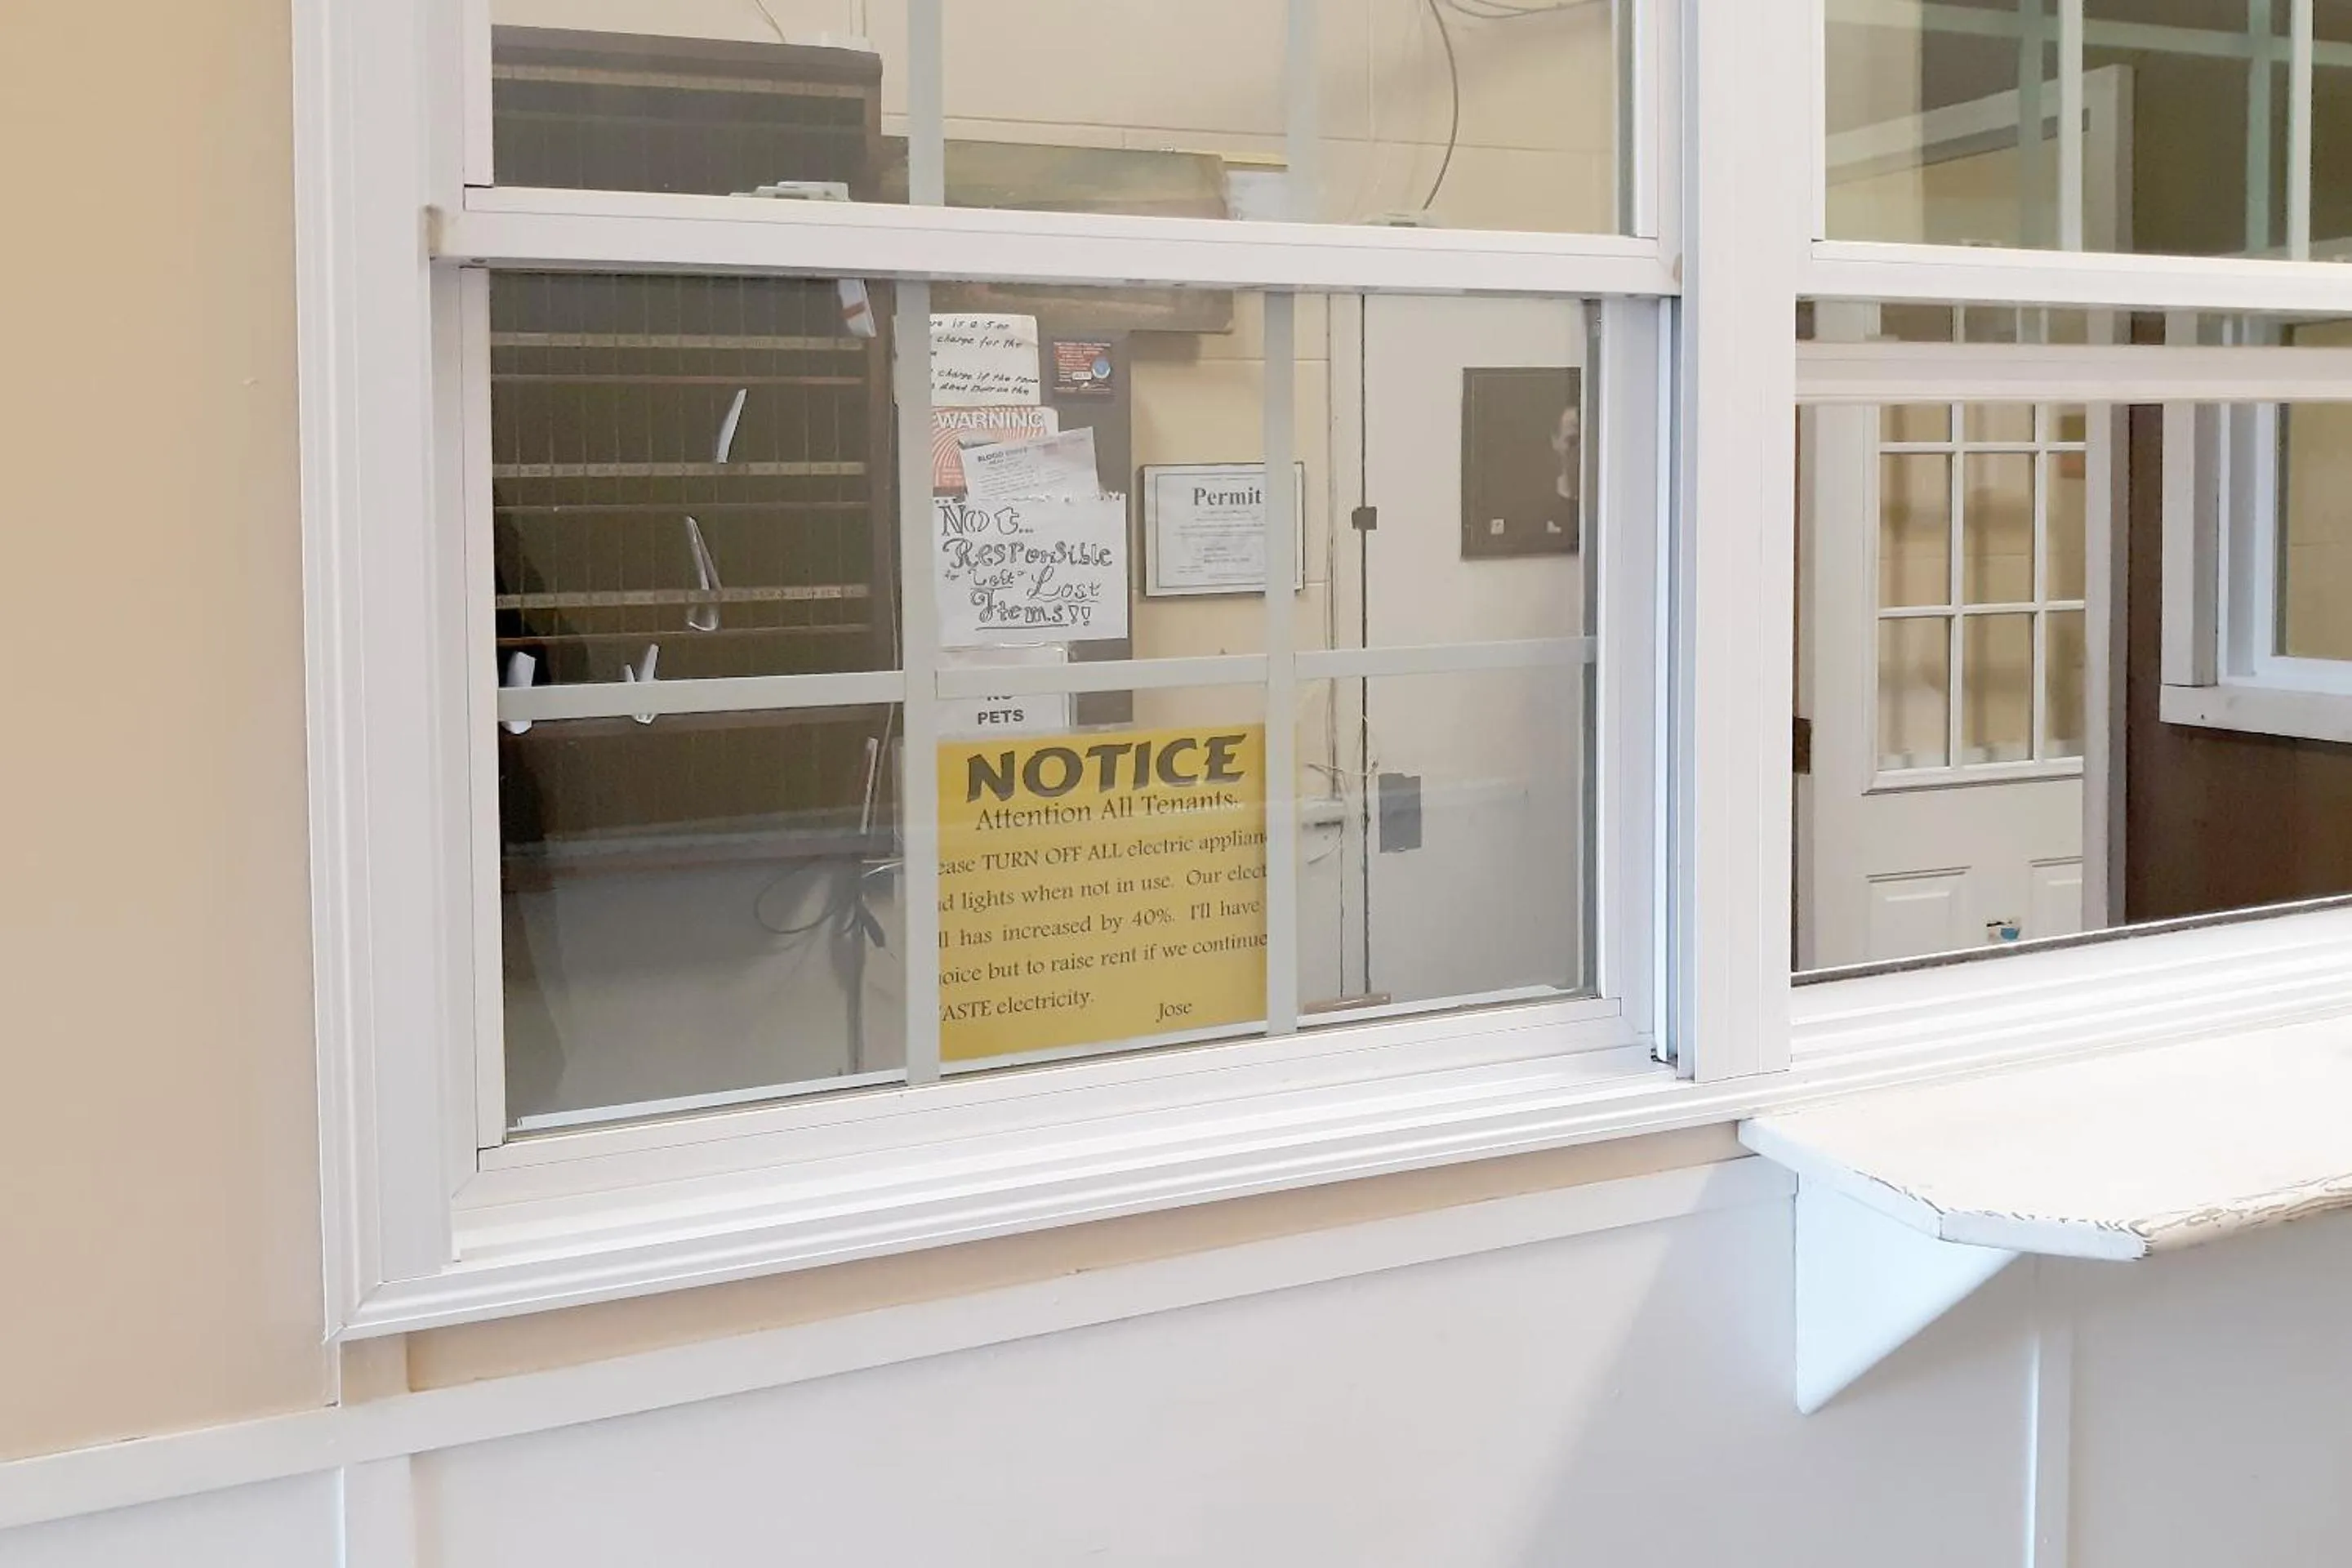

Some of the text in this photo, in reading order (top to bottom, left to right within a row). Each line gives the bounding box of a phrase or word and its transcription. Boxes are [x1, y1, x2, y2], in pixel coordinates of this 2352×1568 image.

[937, 334, 1022, 350] charge for the
[992, 373, 1010, 381] the
[934, 411, 1044, 430] WARNING
[1192, 487, 1263, 506] Permit
[942, 537, 1113, 569] Responsible
[1027, 564, 1102, 599] Lost
[977, 709, 1025, 725] PETS
[965, 733, 1248, 804] NOTICE
[975, 802, 1092, 831] Attention
[1100, 795, 1134, 820] All
[981, 849, 1039, 871] TURN
[1045, 845, 1082, 865] OFF
[1087, 842, 1123, 862] ALL
[1126, 835, 1194, 858] electric
[1199, 829, 1267, 854] applian
[961, 889, 1015, 913] lights
[1022, 884, 1073, 903] when
[1080, 879, 1109, 898] not
[1116, 877, 1134, 893] in
[1142, 875, 1174, 891] use.
[1186, 869, 1223, 886] Our
[960, 928, 992, 946] has
[1002, 915, 1091, 942] increased
[1100, 914, 1125, 934] by
[1132, 907, 1175, 927] 40%.
[1191, 902, 1210, 921] I'll
[1220, 899, 1260, 917] have
[988, 961, 1020, 980] but
[1027, 960, 1045, 975] to
[1050, 952, 1094, 973] raise
[1100, 947, 1137, 966] rent
[1143, 943, 1158, 961] if
[1162, 943, 1187, 958] we
[1192, 933, 1267, 955] continue
[938, 988, 1094, 1022] ASTE electricity.
[1155, 1002, 1193, 1023] Jose
